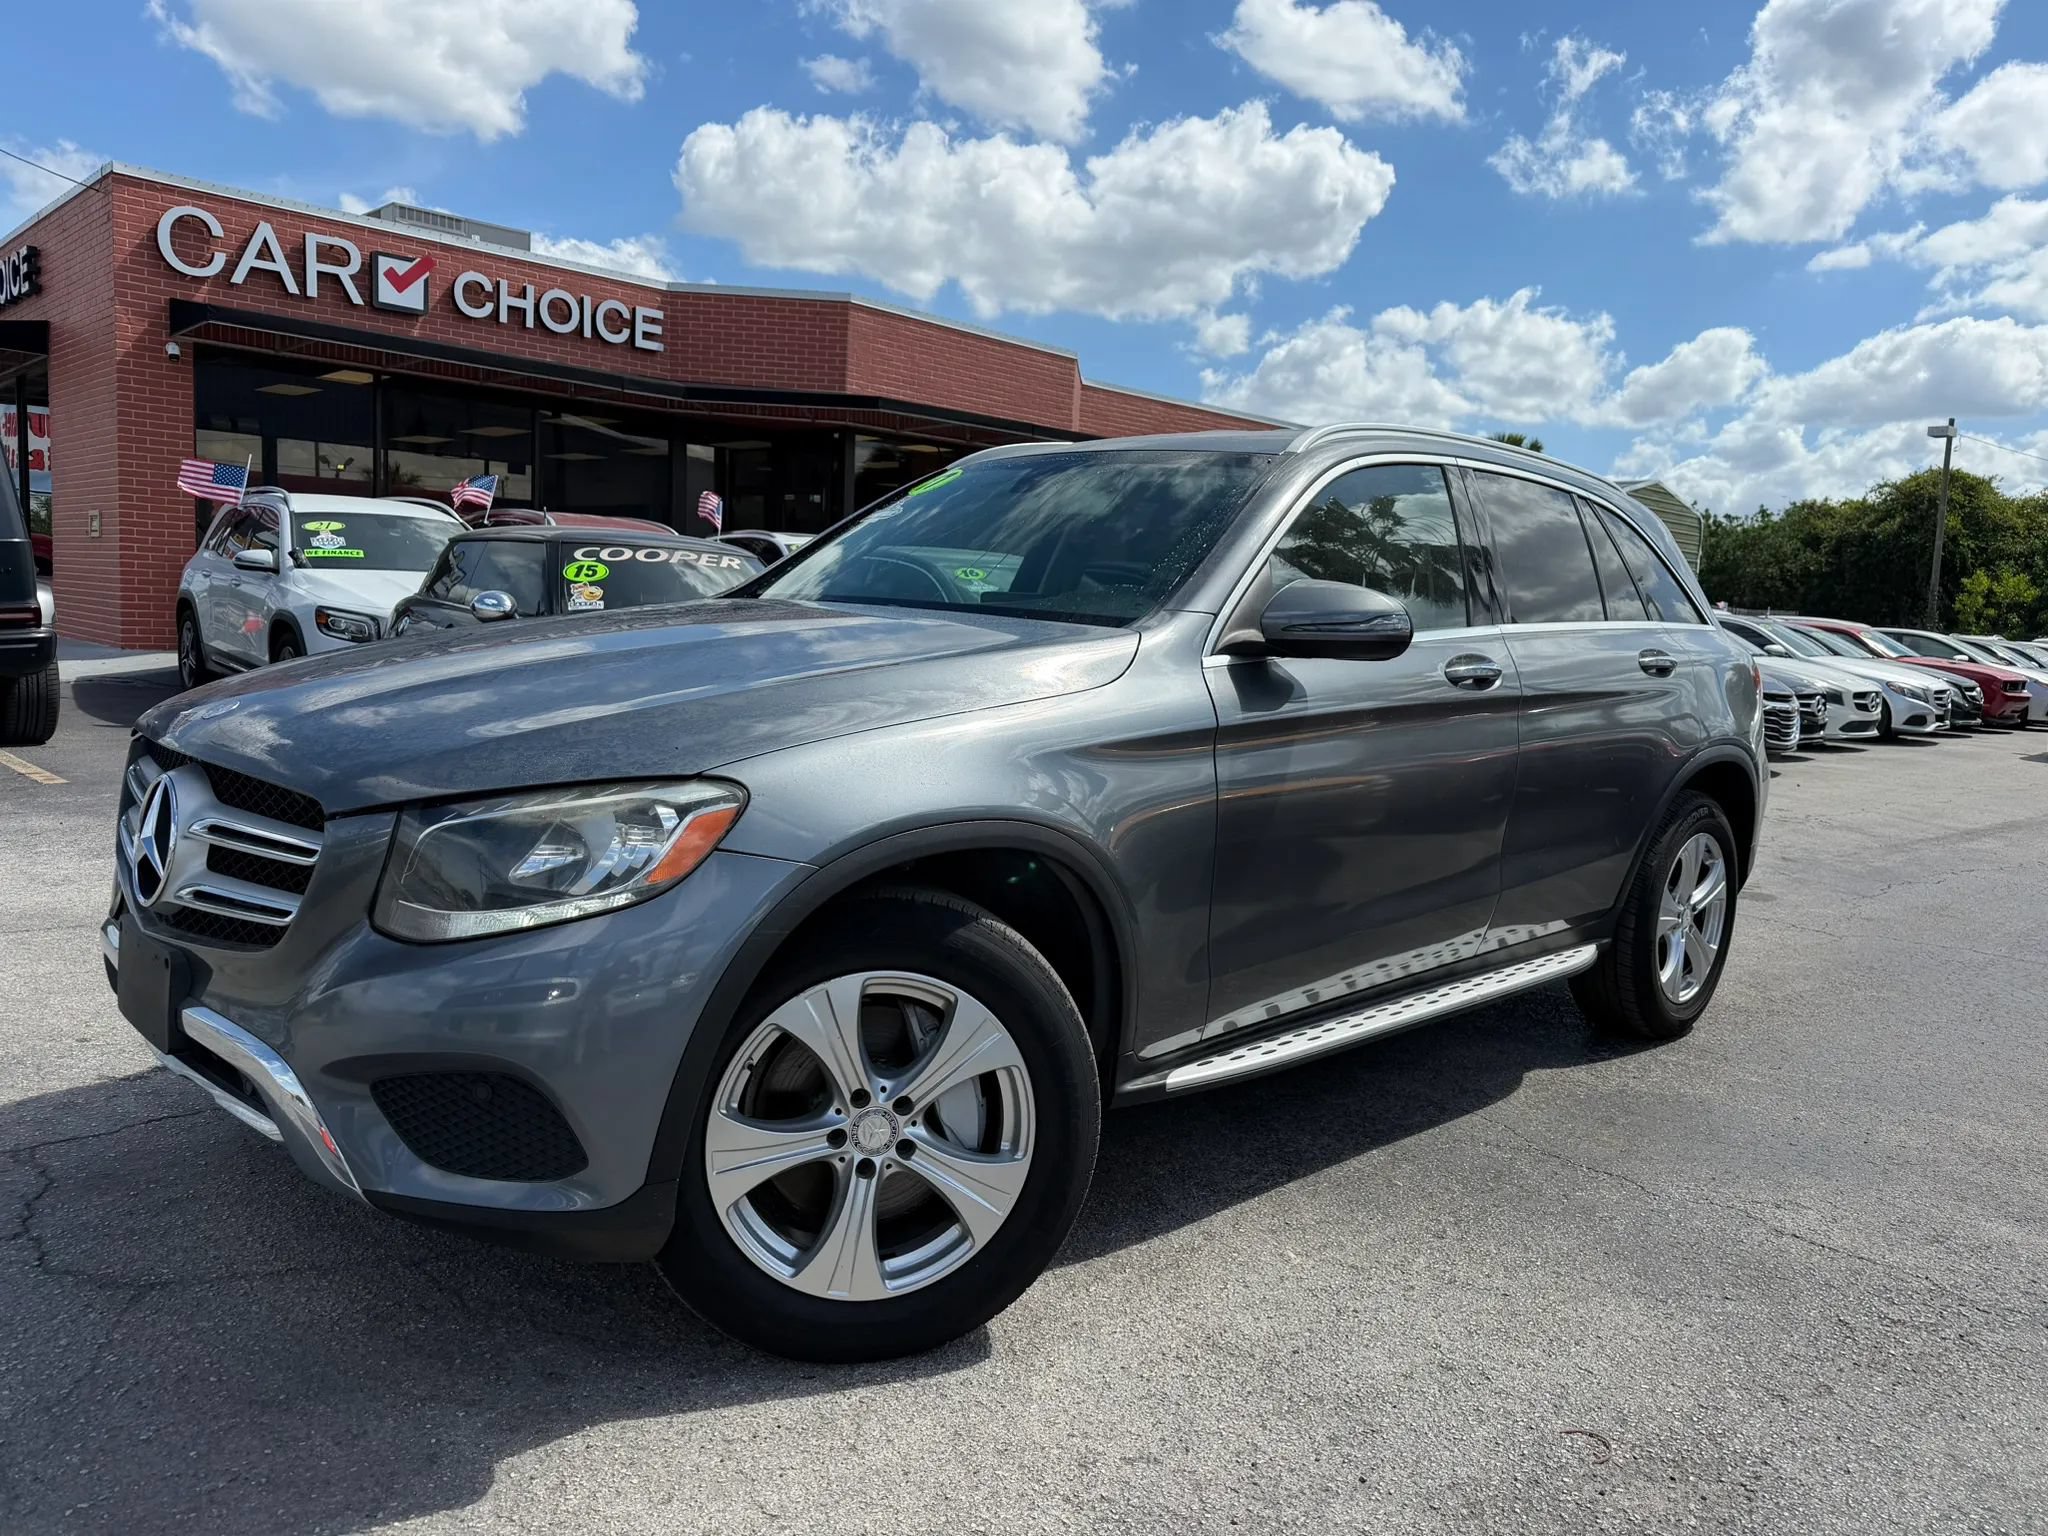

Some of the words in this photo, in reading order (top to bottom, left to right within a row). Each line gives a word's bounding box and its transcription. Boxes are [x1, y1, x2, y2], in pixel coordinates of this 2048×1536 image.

[157, 206, 365, 306] CAR
[453, 271, 665, 352] CHOICE
[573, 547, 741, 570] COOPER
[573, 564, 599, 578] 15
